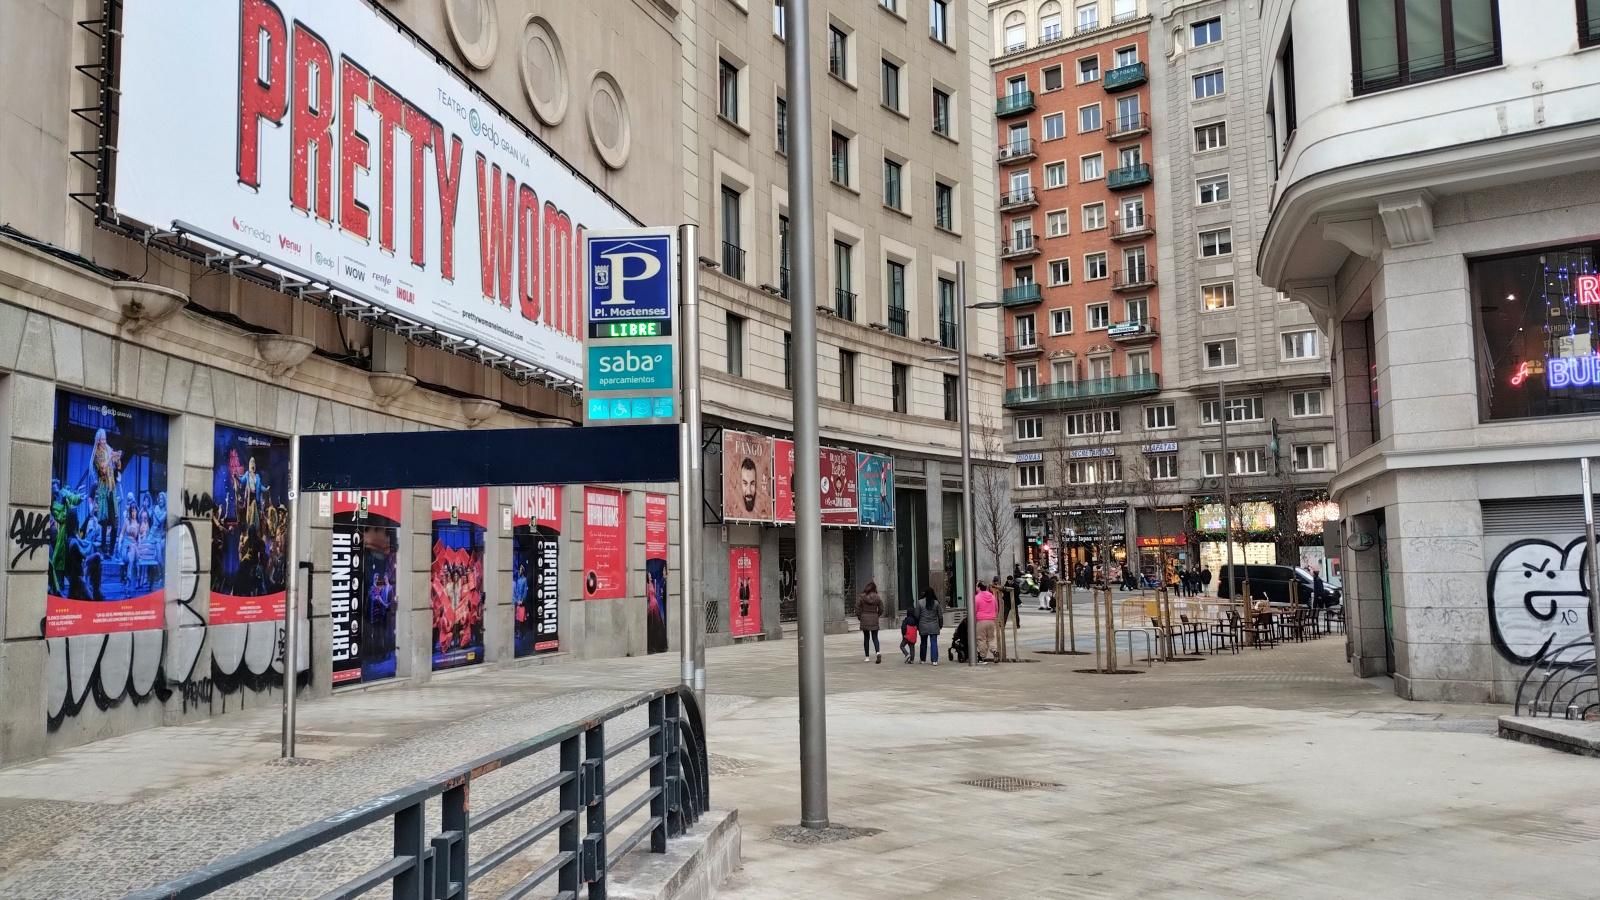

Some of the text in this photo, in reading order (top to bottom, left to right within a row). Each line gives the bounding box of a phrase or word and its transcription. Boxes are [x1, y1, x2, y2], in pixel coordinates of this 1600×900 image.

[437, 88, 467, 120] TEATRO
[481, 122, 500, 148] edp
[501, 139, 519, 160] GRAN
[236, 0, 463, 285] PRETTY
[345, 265, 365, 282] WOW
[372, 271, 391, 287] renfe
[600, 252, 661, 305] P
[595, 307, 666, 317] Pl. Mostenses
[610, 322, 656, 337] LIBRE
[599, 350, 654, 373] saba
[599, 376, 655, 385] aparcamientos
[735, 440, 763, 456] FANGO
[513, 485, 556, 520] MUSICAL
